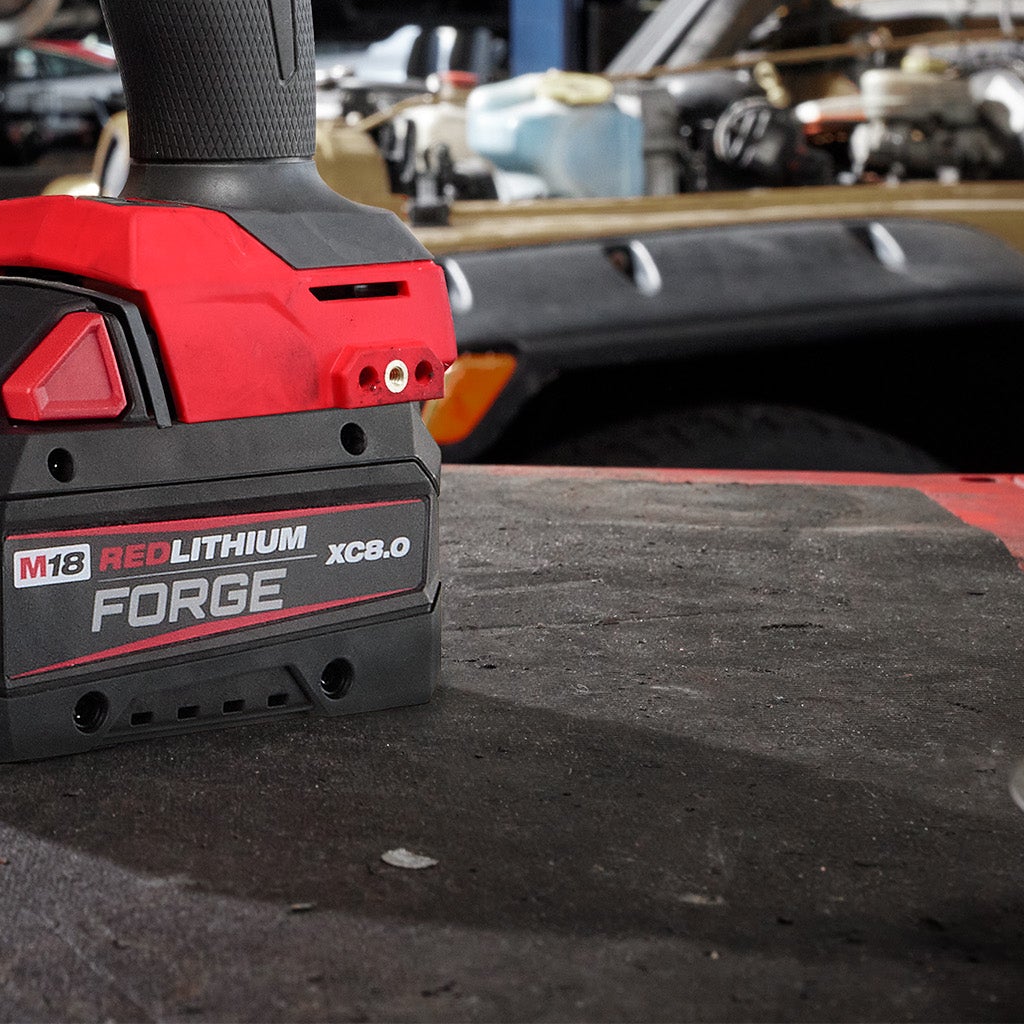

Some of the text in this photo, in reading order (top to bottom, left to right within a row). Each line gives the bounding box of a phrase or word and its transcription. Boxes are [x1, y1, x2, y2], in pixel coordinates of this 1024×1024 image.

[20, 526, 411, 581] M18 REDLITHIUM XC8.0
[91, 568, 288, 633] FORGE
